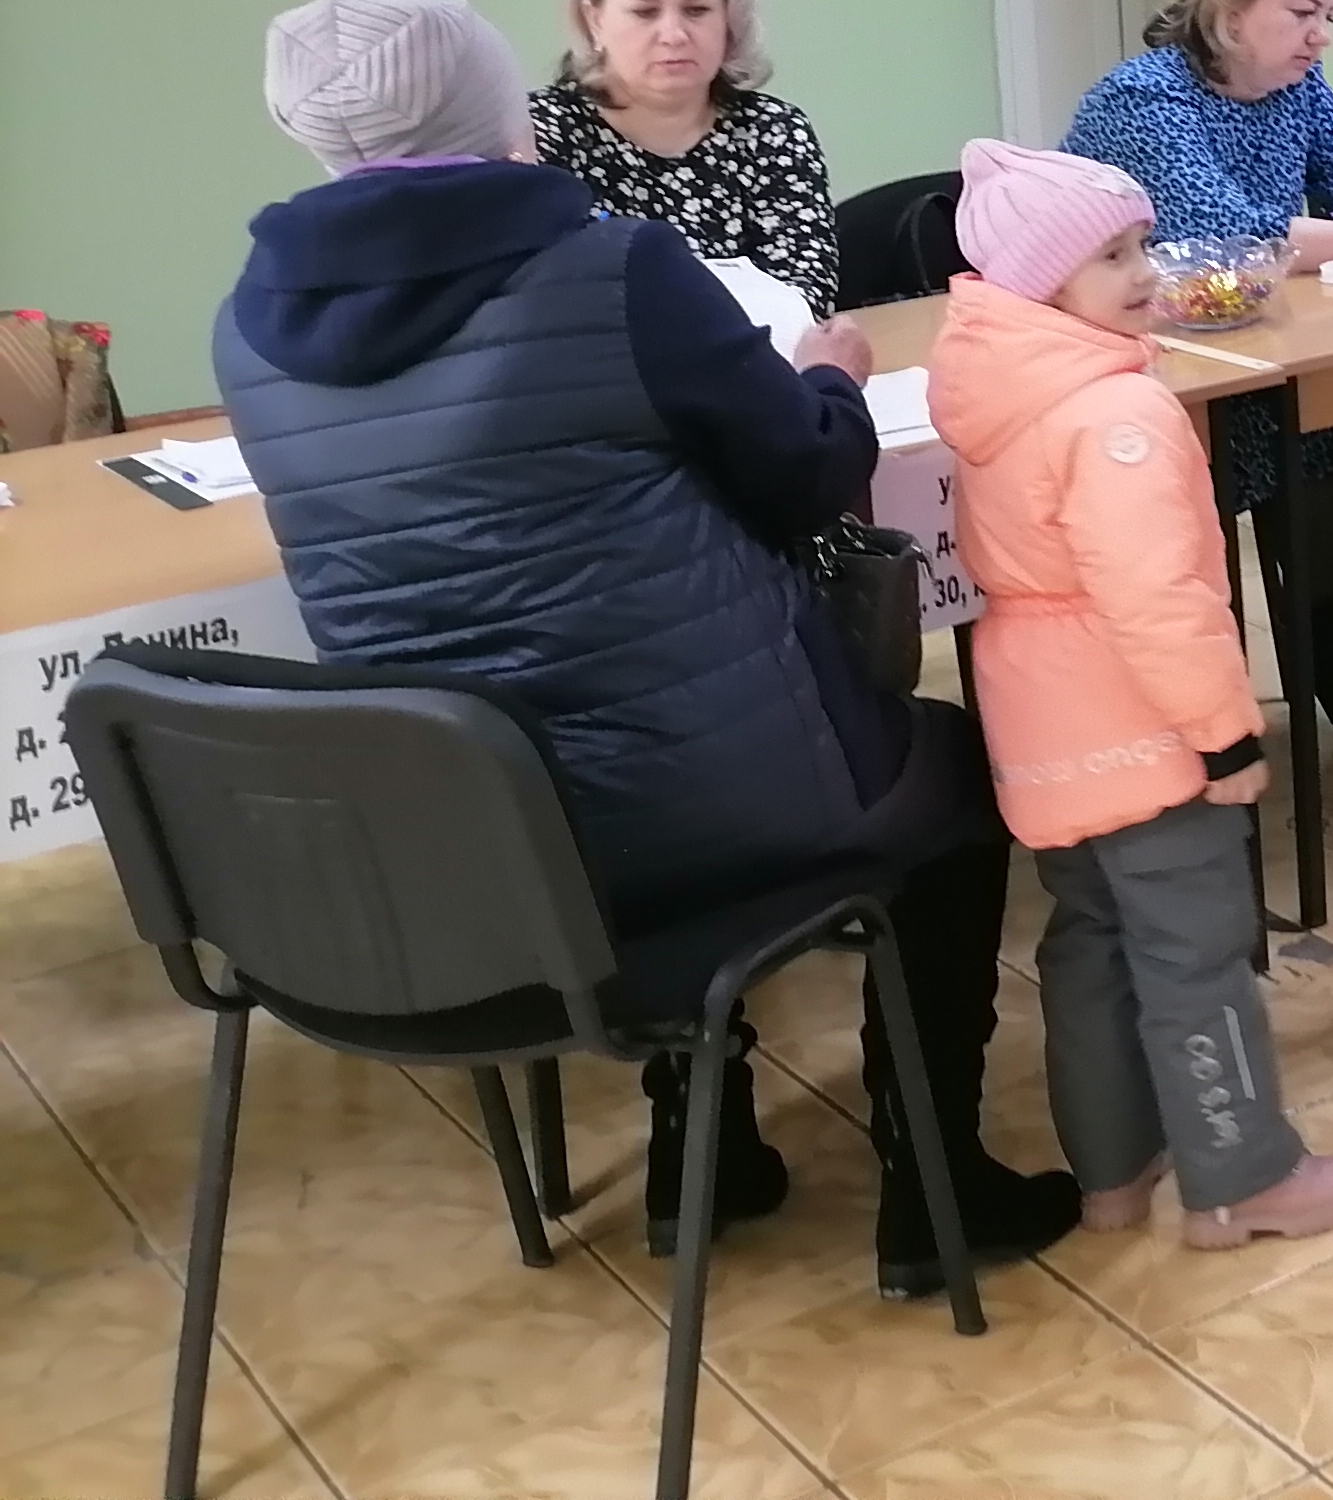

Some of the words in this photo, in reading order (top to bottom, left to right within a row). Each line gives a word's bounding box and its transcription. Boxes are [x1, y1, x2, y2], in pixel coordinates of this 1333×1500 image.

[934, 575, 967, 609] 30,
[103, 617, 239, 650] Лина,
[16, 726, 47, 762] д.
[9, 795, 40, 831] д.
